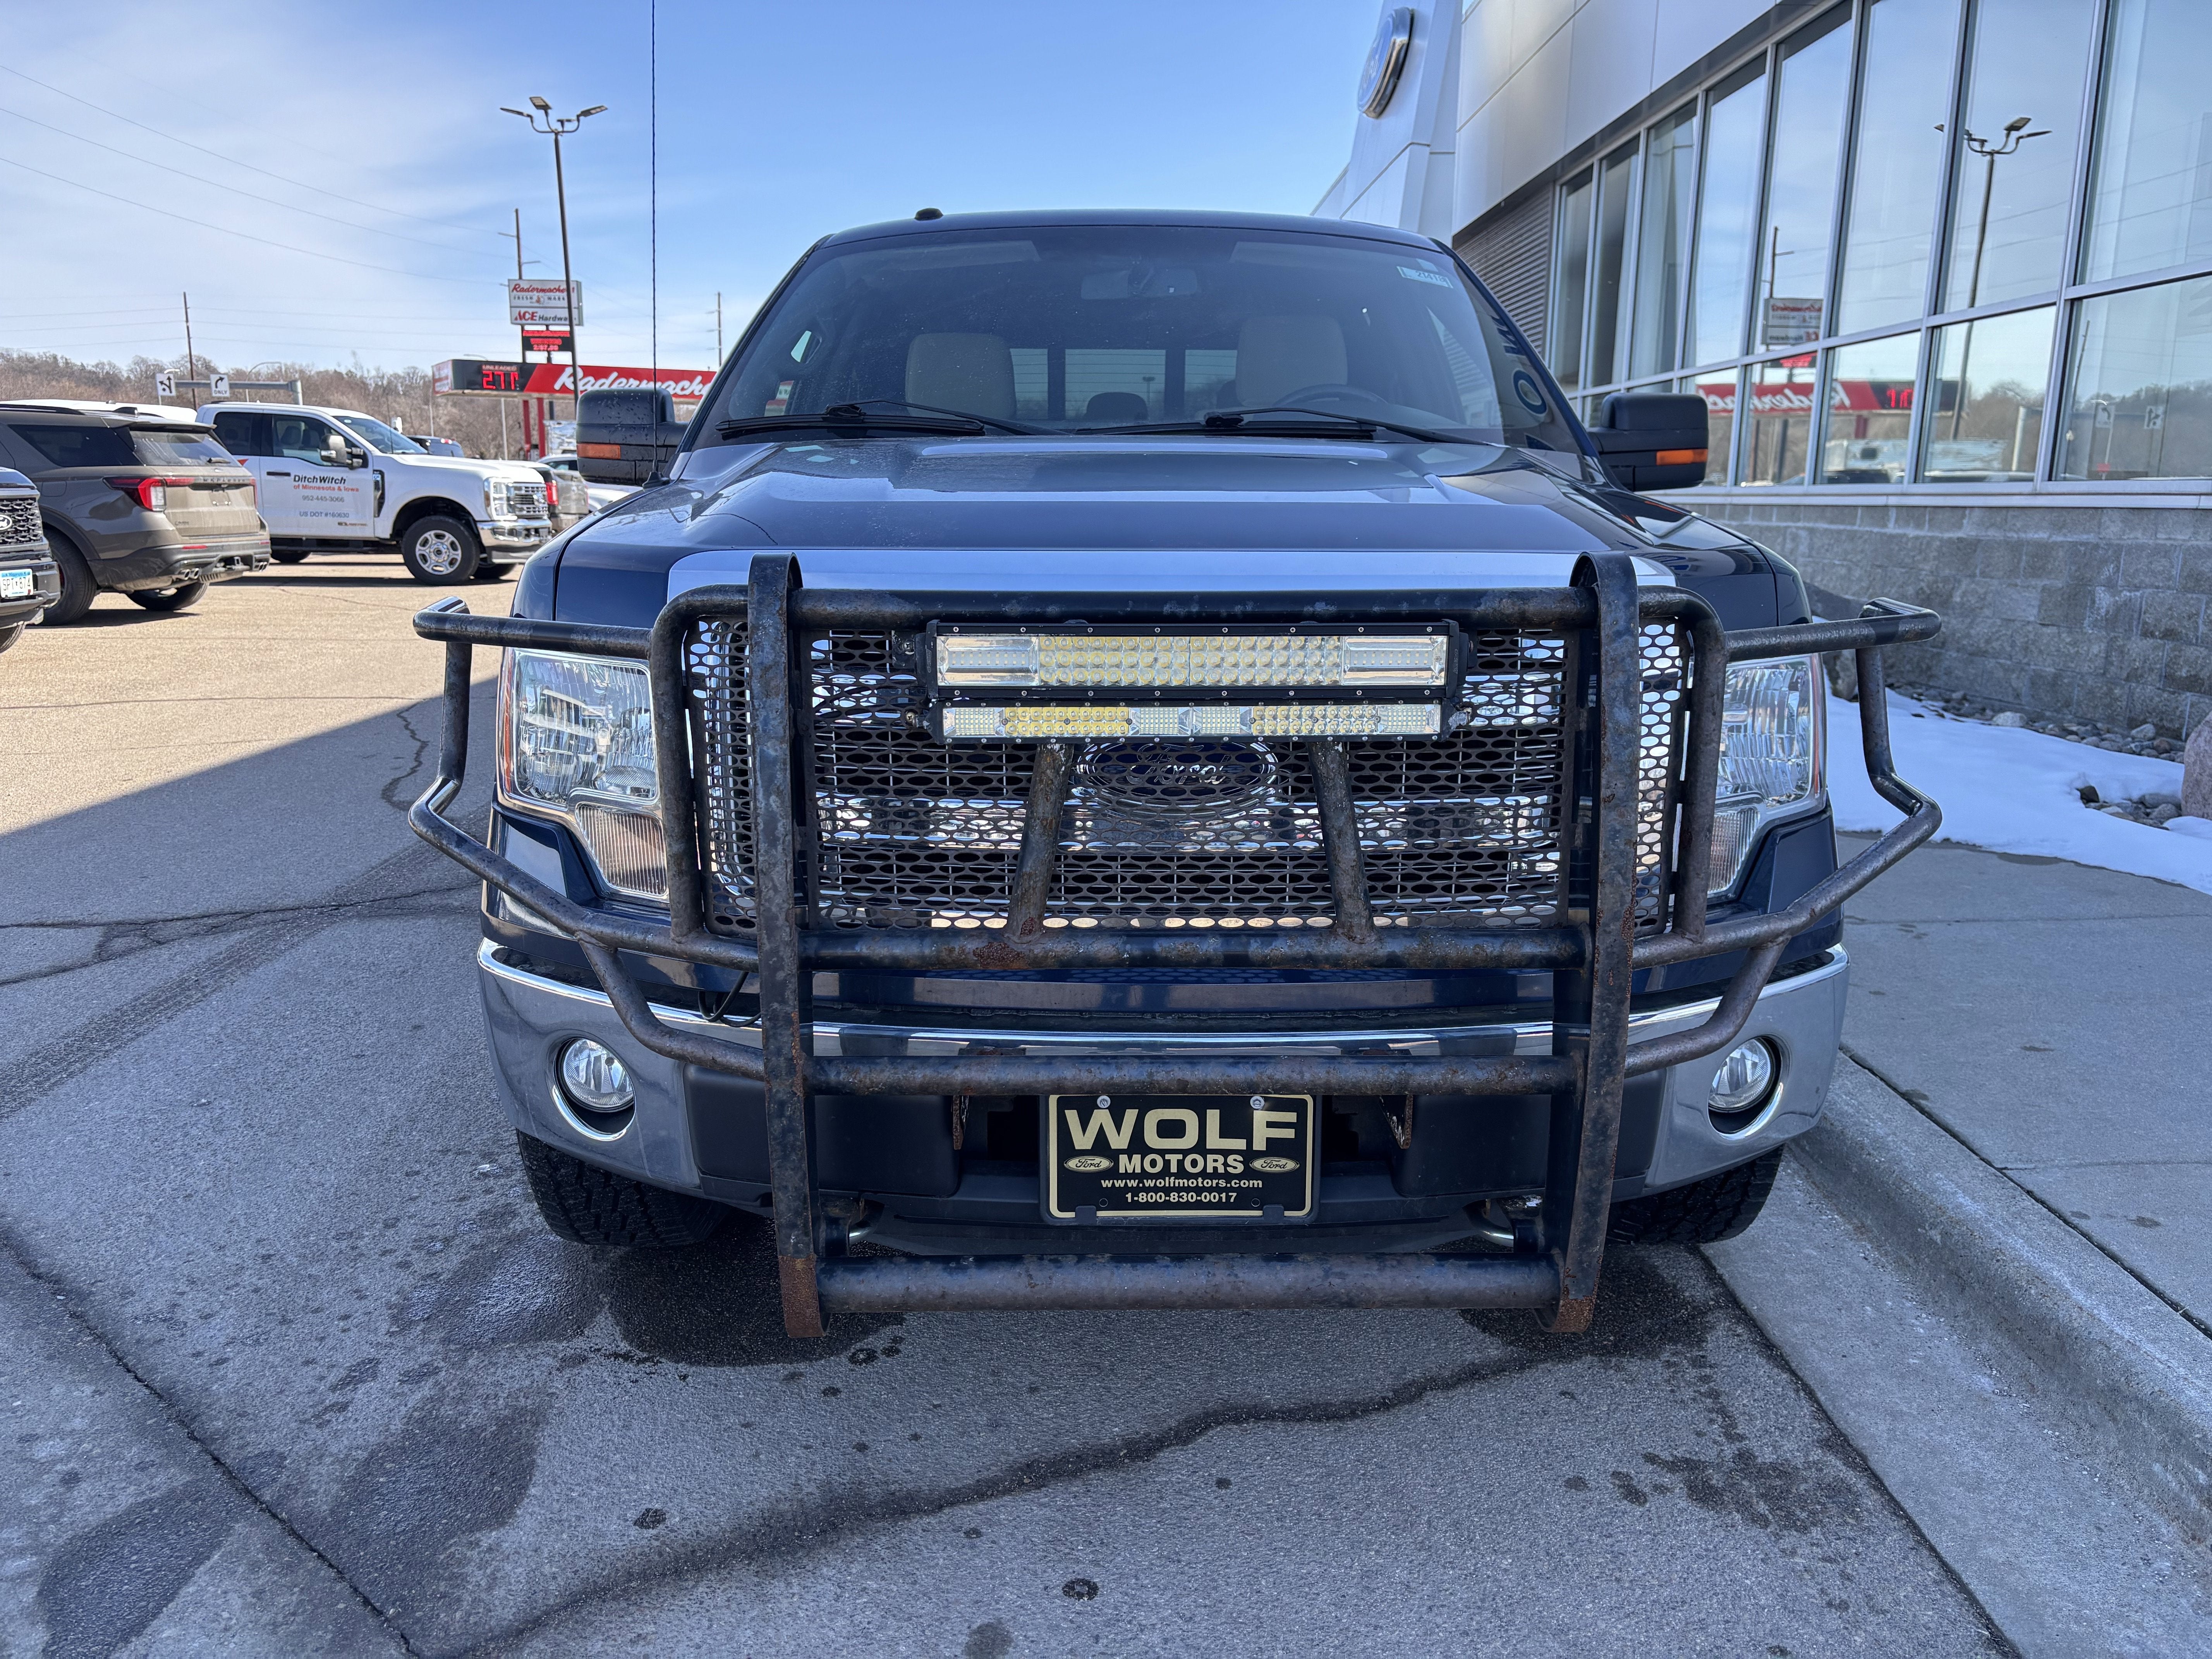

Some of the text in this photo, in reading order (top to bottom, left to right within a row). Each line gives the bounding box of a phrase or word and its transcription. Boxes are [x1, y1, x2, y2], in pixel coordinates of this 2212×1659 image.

[514, 310, 538, 321] ACE
[1065, 1108, 1297, 1151] WOLF
[1075, 1158, 1102, 1168] Ford
[1119, 1154, 1244, 1174] MOTORS
[1261, 1159, 1288, 1169] Ford
[1101, 1176, 1262, 1188] www.wolfmotors.com
[1125, 1192, 1237, 1202] 1-800-830-0017
